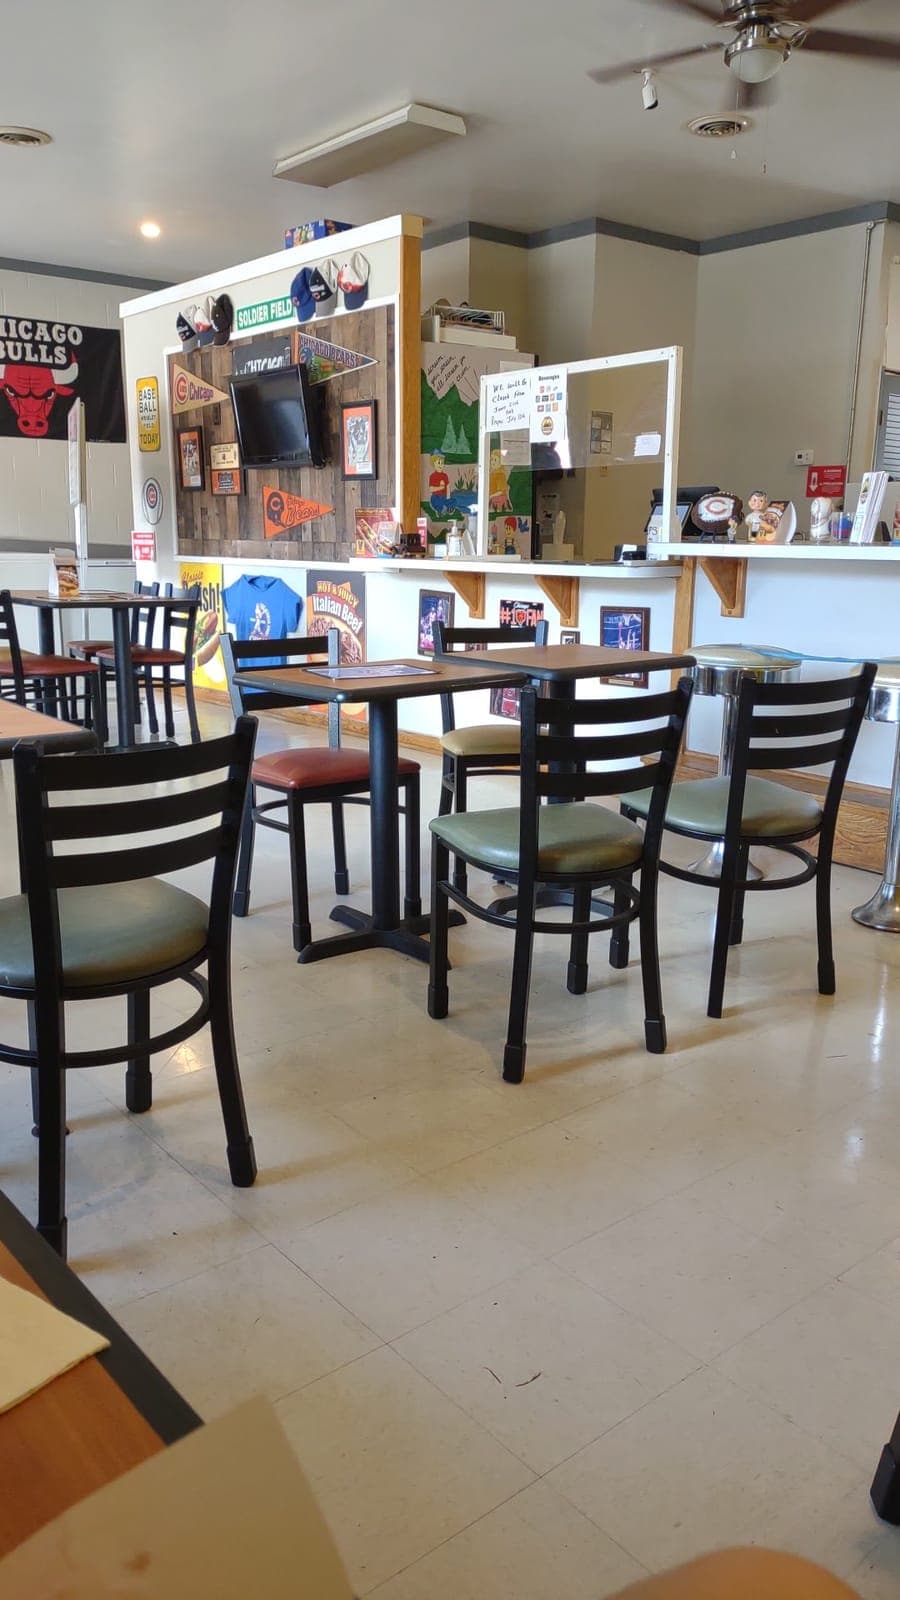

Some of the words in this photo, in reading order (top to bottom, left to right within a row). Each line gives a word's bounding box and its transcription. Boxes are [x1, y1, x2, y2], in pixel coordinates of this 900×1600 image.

[239, 304, 269, 329] SOLDIER
[270, 299, 292, 320] FIELD
[0, 318, 83, 345] ICAGO
[300, 335, 329, 360] CHICAGO
[329, 344, 358, 369] BEARS
[138, 388, 156, 401] BASE
[190, 381, 214, 402] Chicago
[139, 400, 157, 413] BALL
[139, 432, 159, 445] TODAY
[317, 581, 331, 593] HOT
[338, 586, 360, 609] JUICY
[312, 594, 342, 617] Italian
[341, 604, 363, 635] Beef
